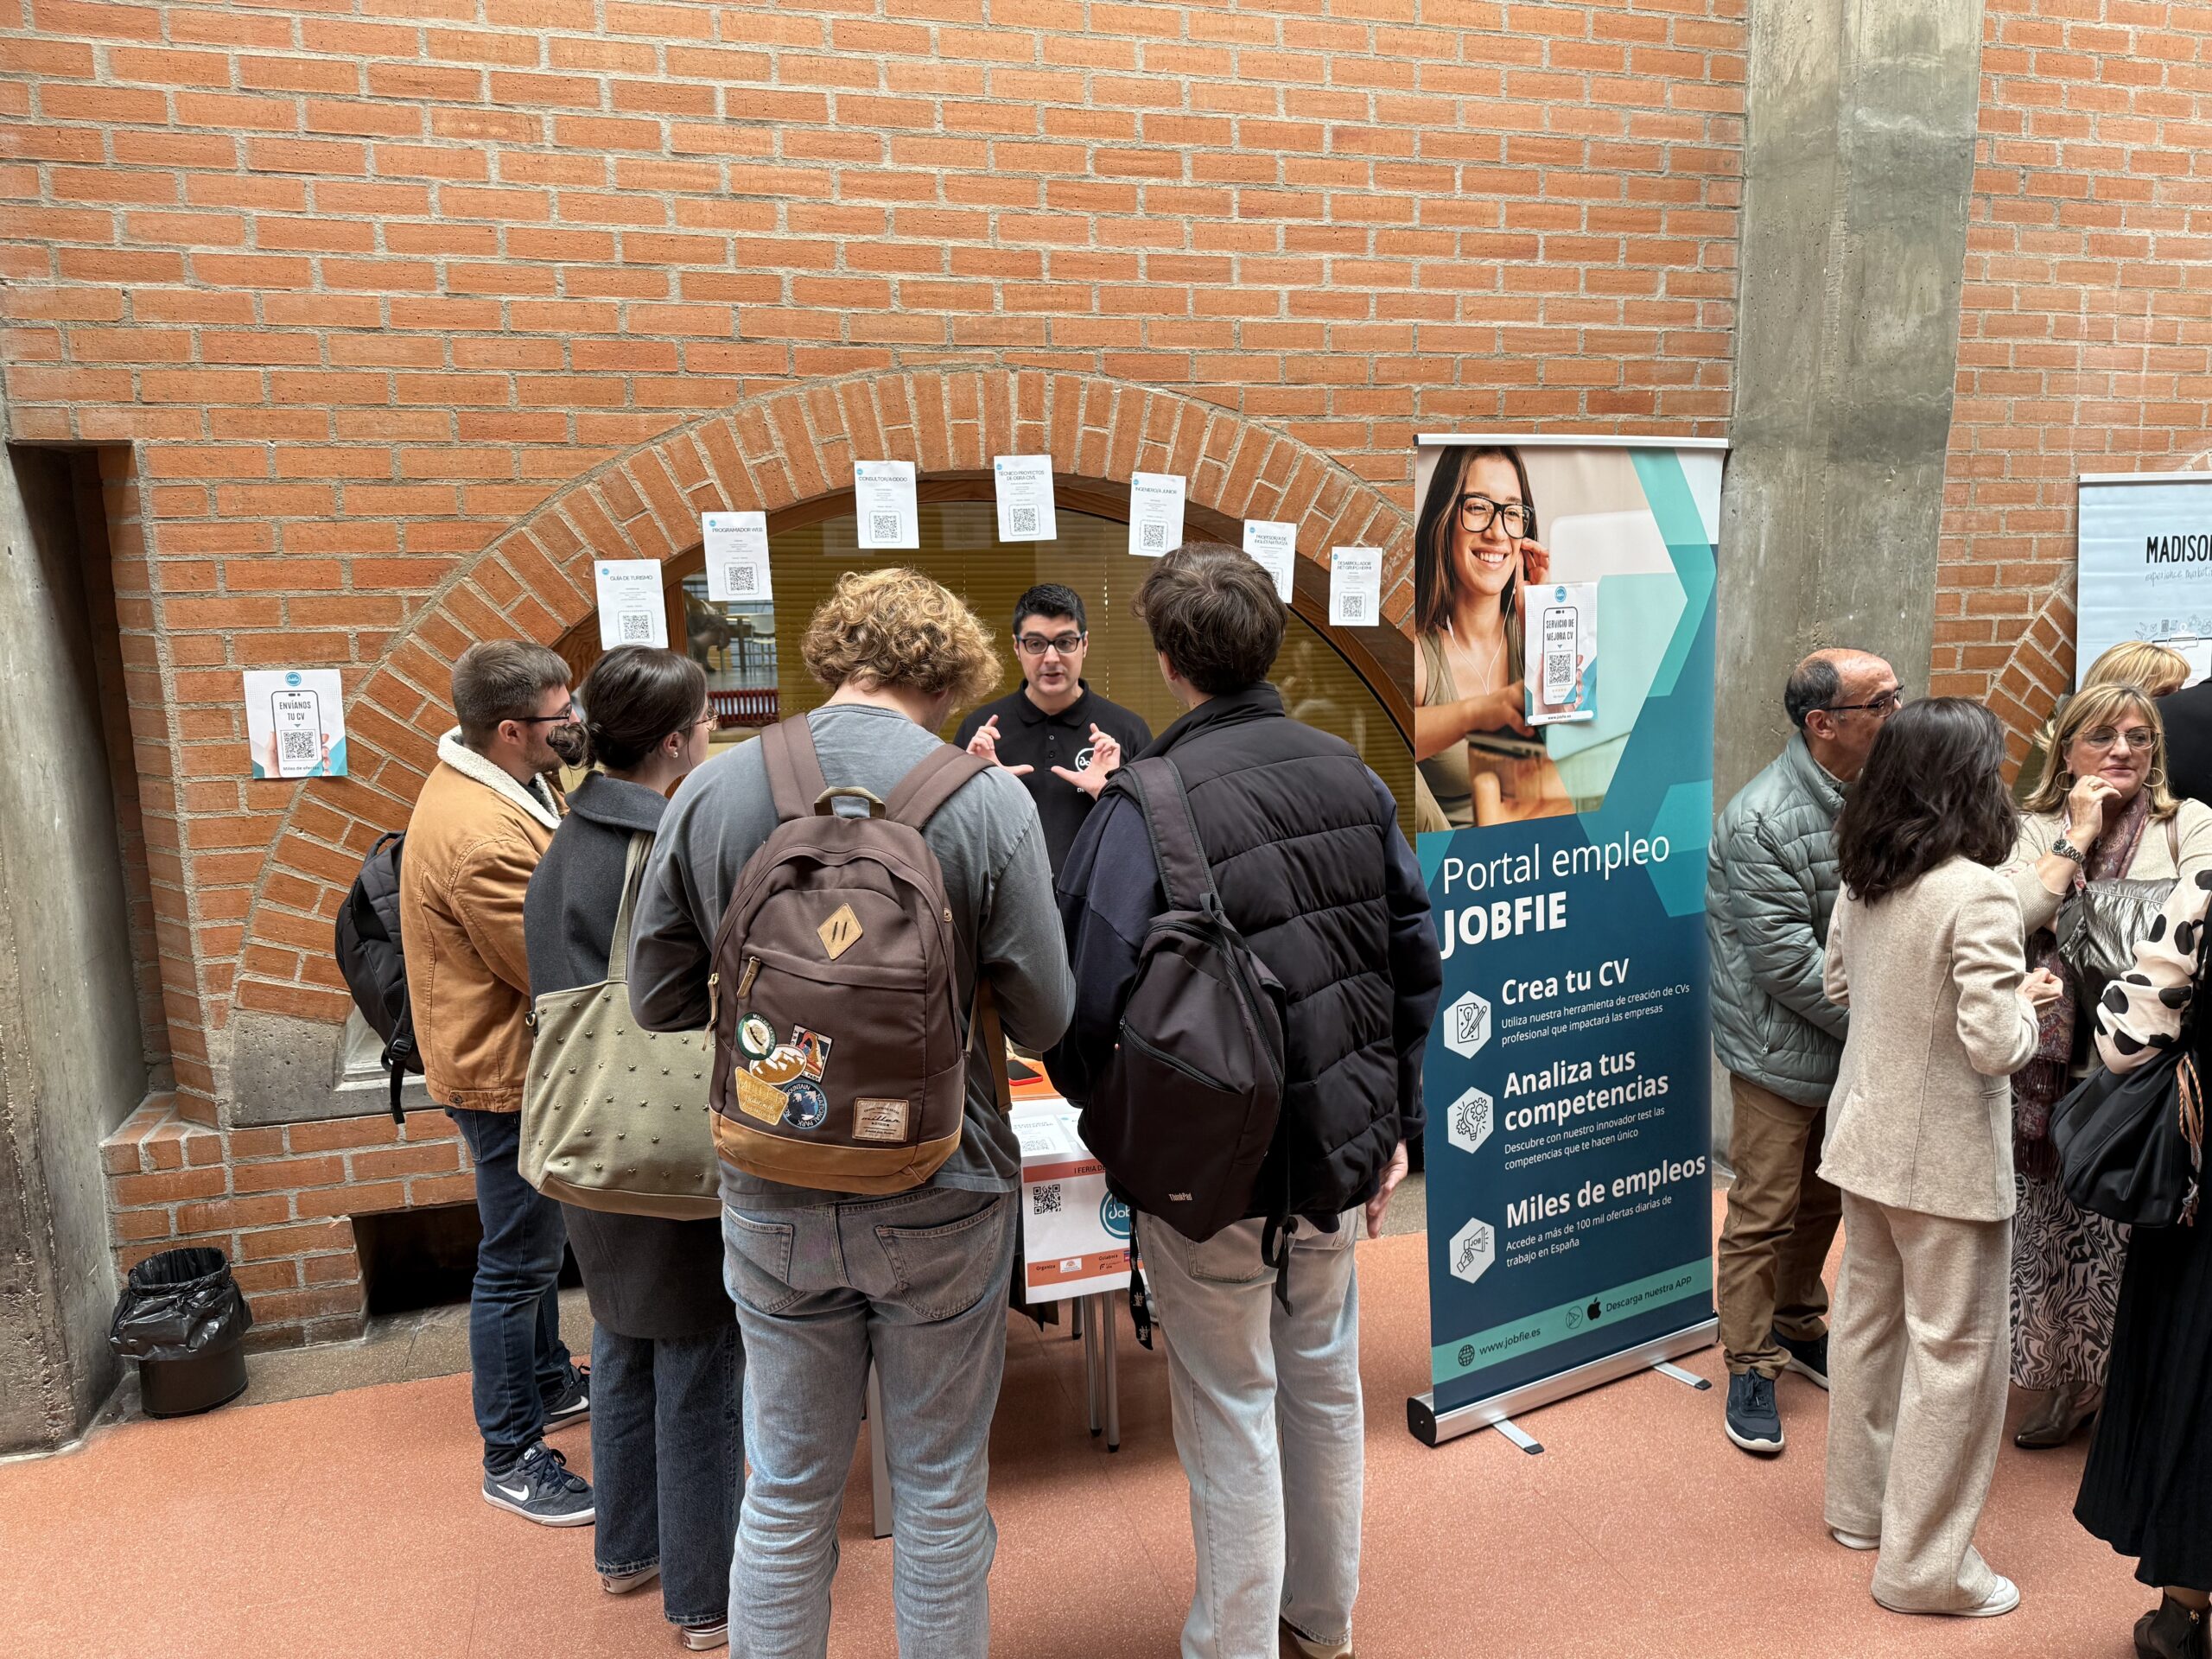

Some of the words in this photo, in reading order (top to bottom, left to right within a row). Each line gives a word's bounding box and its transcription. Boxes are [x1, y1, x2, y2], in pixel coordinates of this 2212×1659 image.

[1546, 620, 1567, 629] SERVICIO
[1568, 619, 1574, 627] DE
[1547, 632, 1567, 641] MEJORA
[1567, 631, 1573, 640] CV
[279, 700, 311, 709] ENVÍANOS
[1444, 843, 1540, 894] Portal
[1552, 831, 1670, 880] empleo
[1440, 891, 1567, 960] JOBFIE
[1502, 977, 1558, 1005] Crea
[1566, 969, 1591, 994] tu
[1599, 958, 1630, 987] CV
[1502, 1014, 1527, 1029] Utiliza
[1529, 1009, 1561, 1023] nuestra
[1563, 1000, 1614, 1016] herramienta
[1616, 995, 1626, 1006] de
[1627, 988, 1661, 1003] creación
[1662, 987, 1673, 996] de
[1675, 983, 1690, 994] CVs
[1502, 1027, 1549, 1047] profesional
[1551, 1025, 1567, 1036] que
[1569, 1014, 1610, 1032] impactará
[1611, 1011, 1623, 1022] las
[1624, 1004, 1663, 1019] empresas
[1503, 1059, 1592, 1098] Analiza
[1599, 1051, 1636, 1077] tus
[1505, 1074, 1669, 1131] competencias
[1504, 1135, 1544, 1154] Descubre
[1546, 1134, 1561, 1144] con
[1563, 1123, 1594, 1141] nuestro
[1596, 1113, 1636, 1131] innovador
[1637, 1110, 1652, 1121] test
[1654, 1106, 1665, 1116] las
[1504, 1148, 1562, 1170] competencias
[1564, 1145, 1580, 1155] que
[1581, 1141, 1590, 1150] te
[1592, 1135, 1615, 1148] hacen
[1618, 1129, 1638, 1141] único
[1507, 1192, 1570, 1229] Miles
[1577, 1180, 1605, 1208] de
[1611, 1155, 1706, 1195] empleos
[1506, 1236, 1535, 1251] Accede
[1537, 1233, 1543, 1242] a
[1545, 1227, 1562, 1240] más
[1564, 1224, 1574, 1235] de
[1576, 1217, 1591, 1230] 100
[1592, 1213, 1605, 1225] mil
[1606, 1207, 1634, 1222] ofertas
[1635, 1199, 1660, 1214] diarias
[1662, 1195, 1672, 1205] de
[1507, 1250, 1536, 1267] trabajo
[1538, 1249, 1548, 1258] en
[1550, 1237, 1580, 1254] España
[1606, 1294, 1643, 1313] Descarga
[1644, 1284, 1674, 1300] nuestra
[1479, 1327, 1541, 1355] www.jobfie.es
